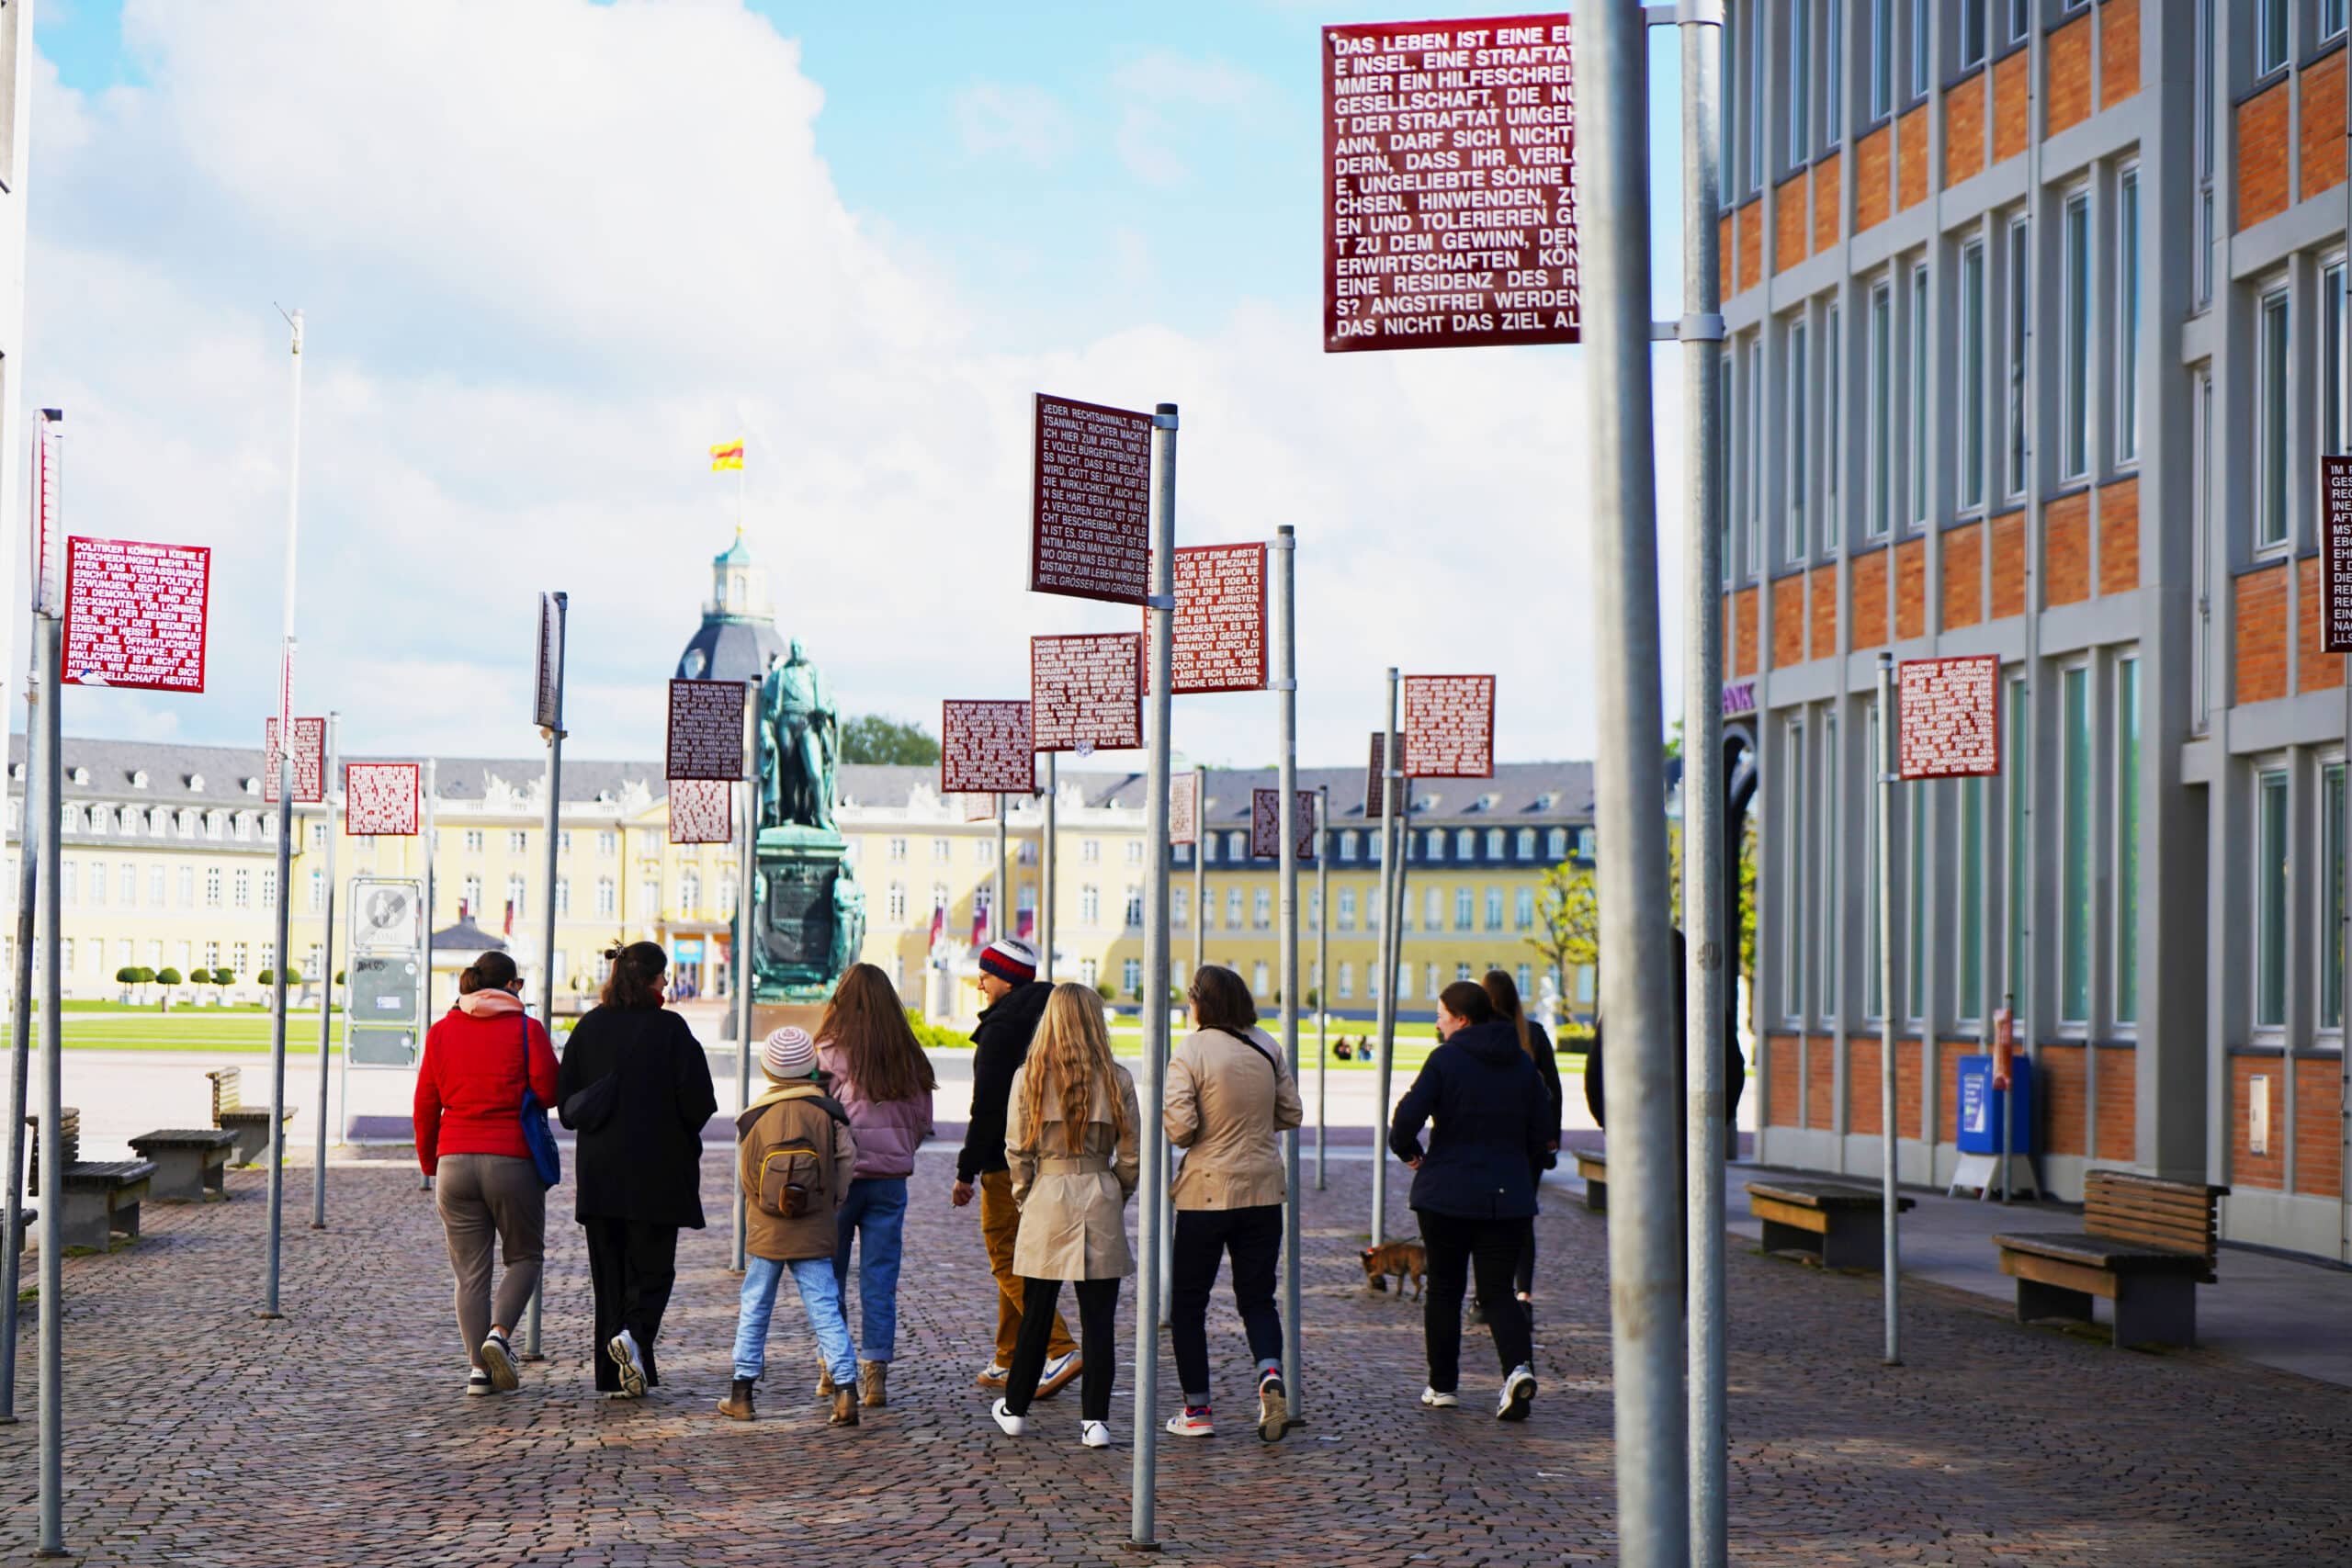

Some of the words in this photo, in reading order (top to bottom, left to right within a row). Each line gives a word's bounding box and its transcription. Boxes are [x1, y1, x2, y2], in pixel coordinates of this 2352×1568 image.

[1335, 36, 1376, 55] DAS
[1383, 32, 1450, 51] LEBEN
[1457, 29, 1490, 48] IST
[1497, 27, 1544, 46] EINE
[1335, 58, 1347, 75] E
[1353, 53, 1416, 73] INSEL.
[1423, 51, 1470, 70] EINE
[1335, 75, 1393, 95] MMER
[1399, 73, 1432, 91] EIN
[1335, 89, 1495, 117] GESELLSCHAFT,
[1507, 86, 1540, 105] DIE
[1335, 118, 1346, 134] T
[1352, 115, 1392, 133] DER
[1397, 109, 1499, 130] STRAFTAT
[1336, 136, 1380, 157] ANN,
[1390, 132, 1444, 151] DARF
[1453, 129, 1501, 148] SICH
[1510, 126, 1572, 145] NICHT
[1336, 155, 1393, 177] DERN,
[1406, 151, 1461, 170] DASS
[1472, 149, 1506, 167] IHR
[1336, 177, 1351, 197] E,
[1360, 171, 1486, 193] UNGELIEBTE
[1491, 164, 1563, 187] SÖHNE
[1336, 195, 1407, 215] CHSEN.
[1419, 187, 1546, 213] HINWENDEN,
[1336, 217, 1362, 235] EN
[1370, 215, 1412, 233] UND
[1419, 209, 1548, 231] TOLERIEREN
[1336, 237, 1347, 254] T
[1355, 236, 1381, 254] ZU
[1390, 233, 1433, 252] DEM
[1442, 230, 1530, 253] GEWINN,
[1337, 251, 1520, 275] ERWIRTSCHAFTEN
[1337, 276, 1380, 296] EINE
[1394, 272, 1494, 293] RESIDENZ
[1508, 269, 1549, 288] DES
[1337, 298, 1360, 316] S?
[1371, 293, 1484, 314] ANGSTFREI
[1337, 319, 1376, 336] DAS
[1385, 316, 1443, 334] NICHT
[1453, 314, 1494, 332] DAS
[1501, 311, 1545, 331] ZIEL
